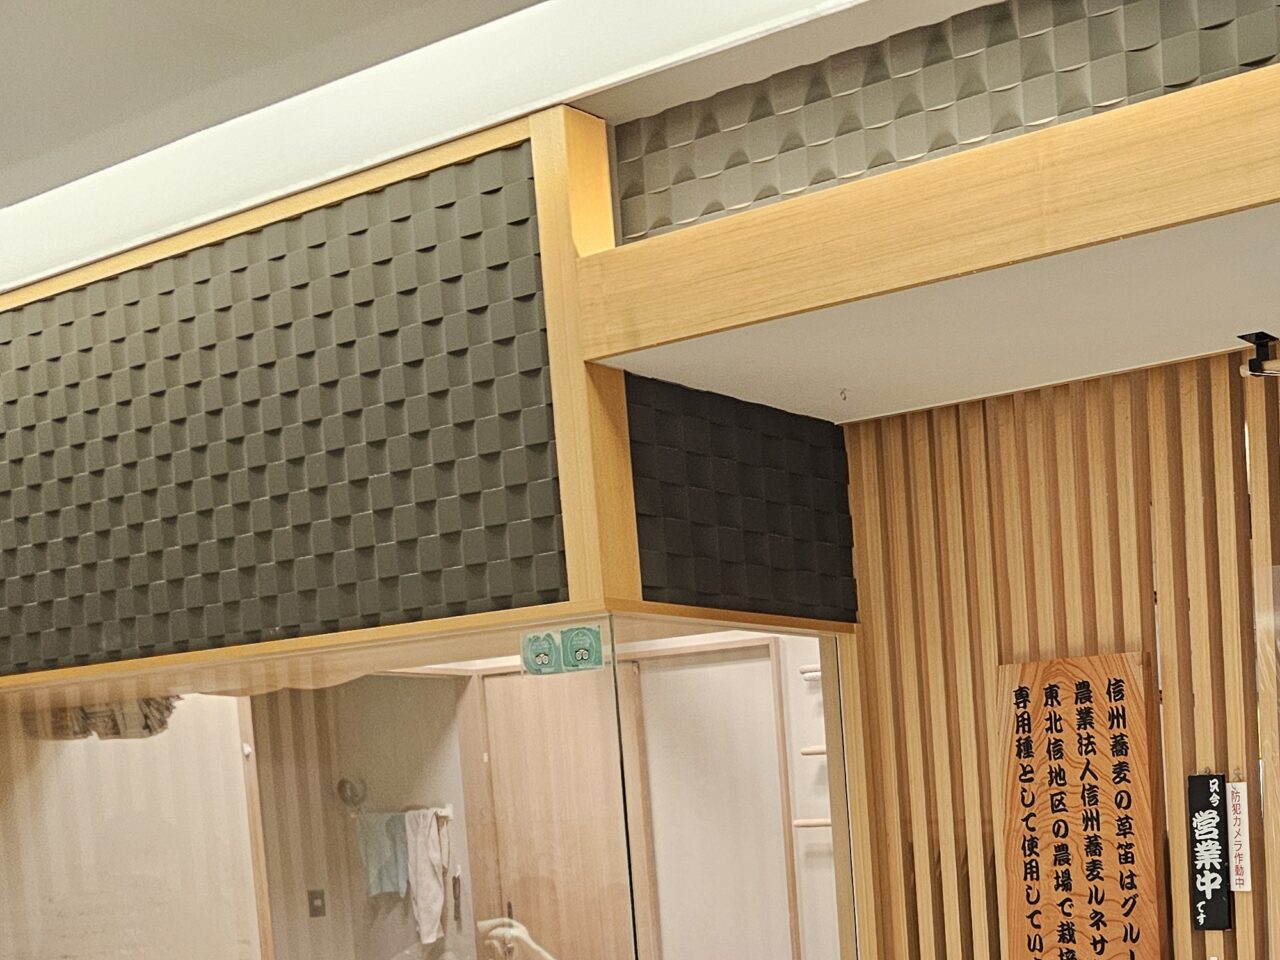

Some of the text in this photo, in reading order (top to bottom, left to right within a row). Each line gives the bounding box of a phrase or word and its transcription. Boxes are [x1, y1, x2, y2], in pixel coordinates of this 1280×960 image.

[1231, 790, 1245, 888] 防犯カメラ作動中
